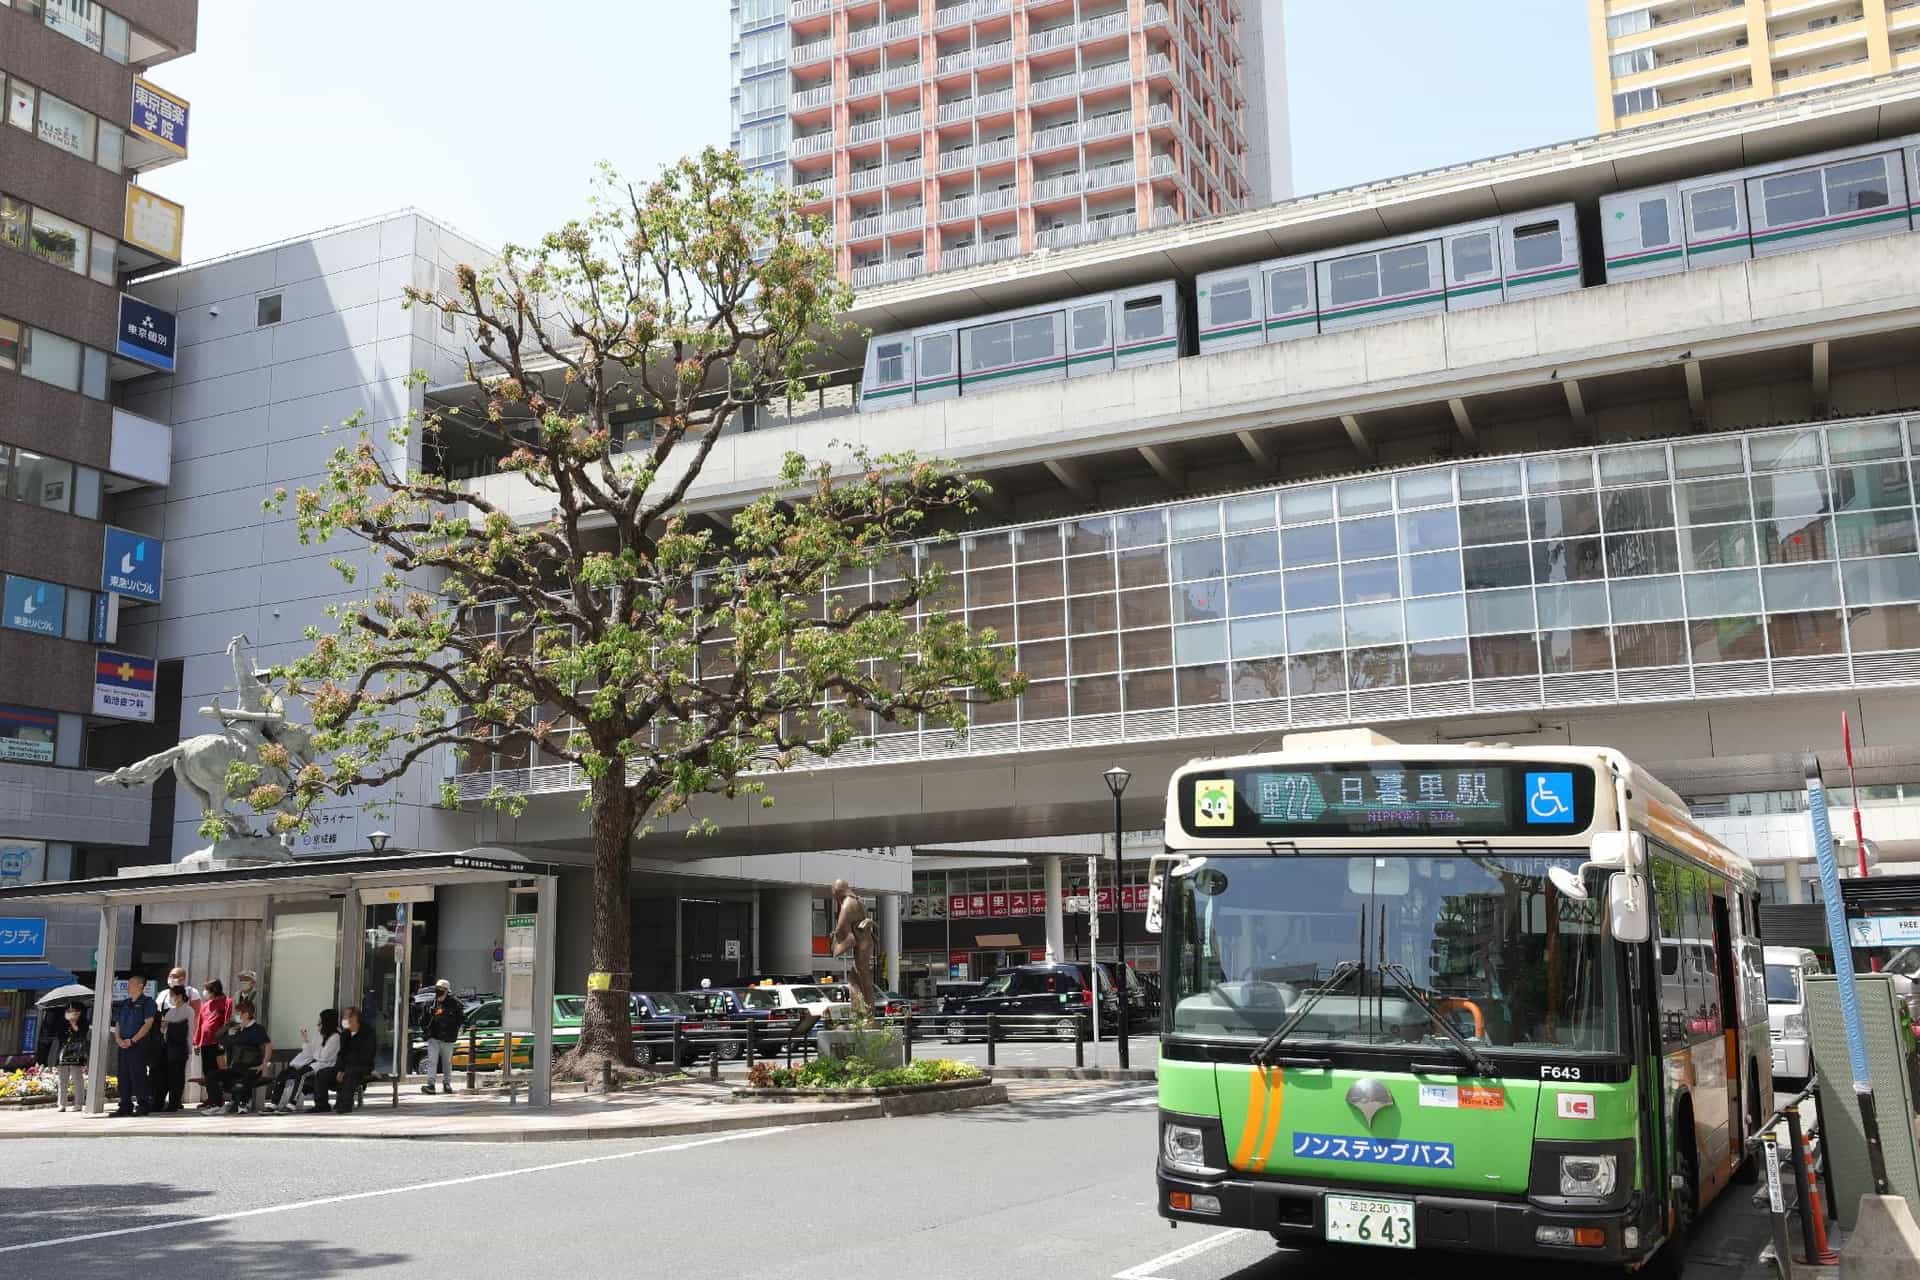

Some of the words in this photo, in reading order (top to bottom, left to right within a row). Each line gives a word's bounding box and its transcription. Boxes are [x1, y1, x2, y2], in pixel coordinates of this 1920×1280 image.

[135, 85, 185, 126] 東京音楽
[144, 110, 174, 141] 学院
[128, 323, 167, 346] 東京個別
[109, 575, 154, 594] 東急リバブル
[14, 615, 55, 631] 東急リバブル
[1263, 776, 1314, 820] 里22
[1342, 772, 1490, 805] 日暮里駅
[1541, 1065, 1581, 1080] F643
[1294, 1136, 1453, 1166] ノンステップバス
